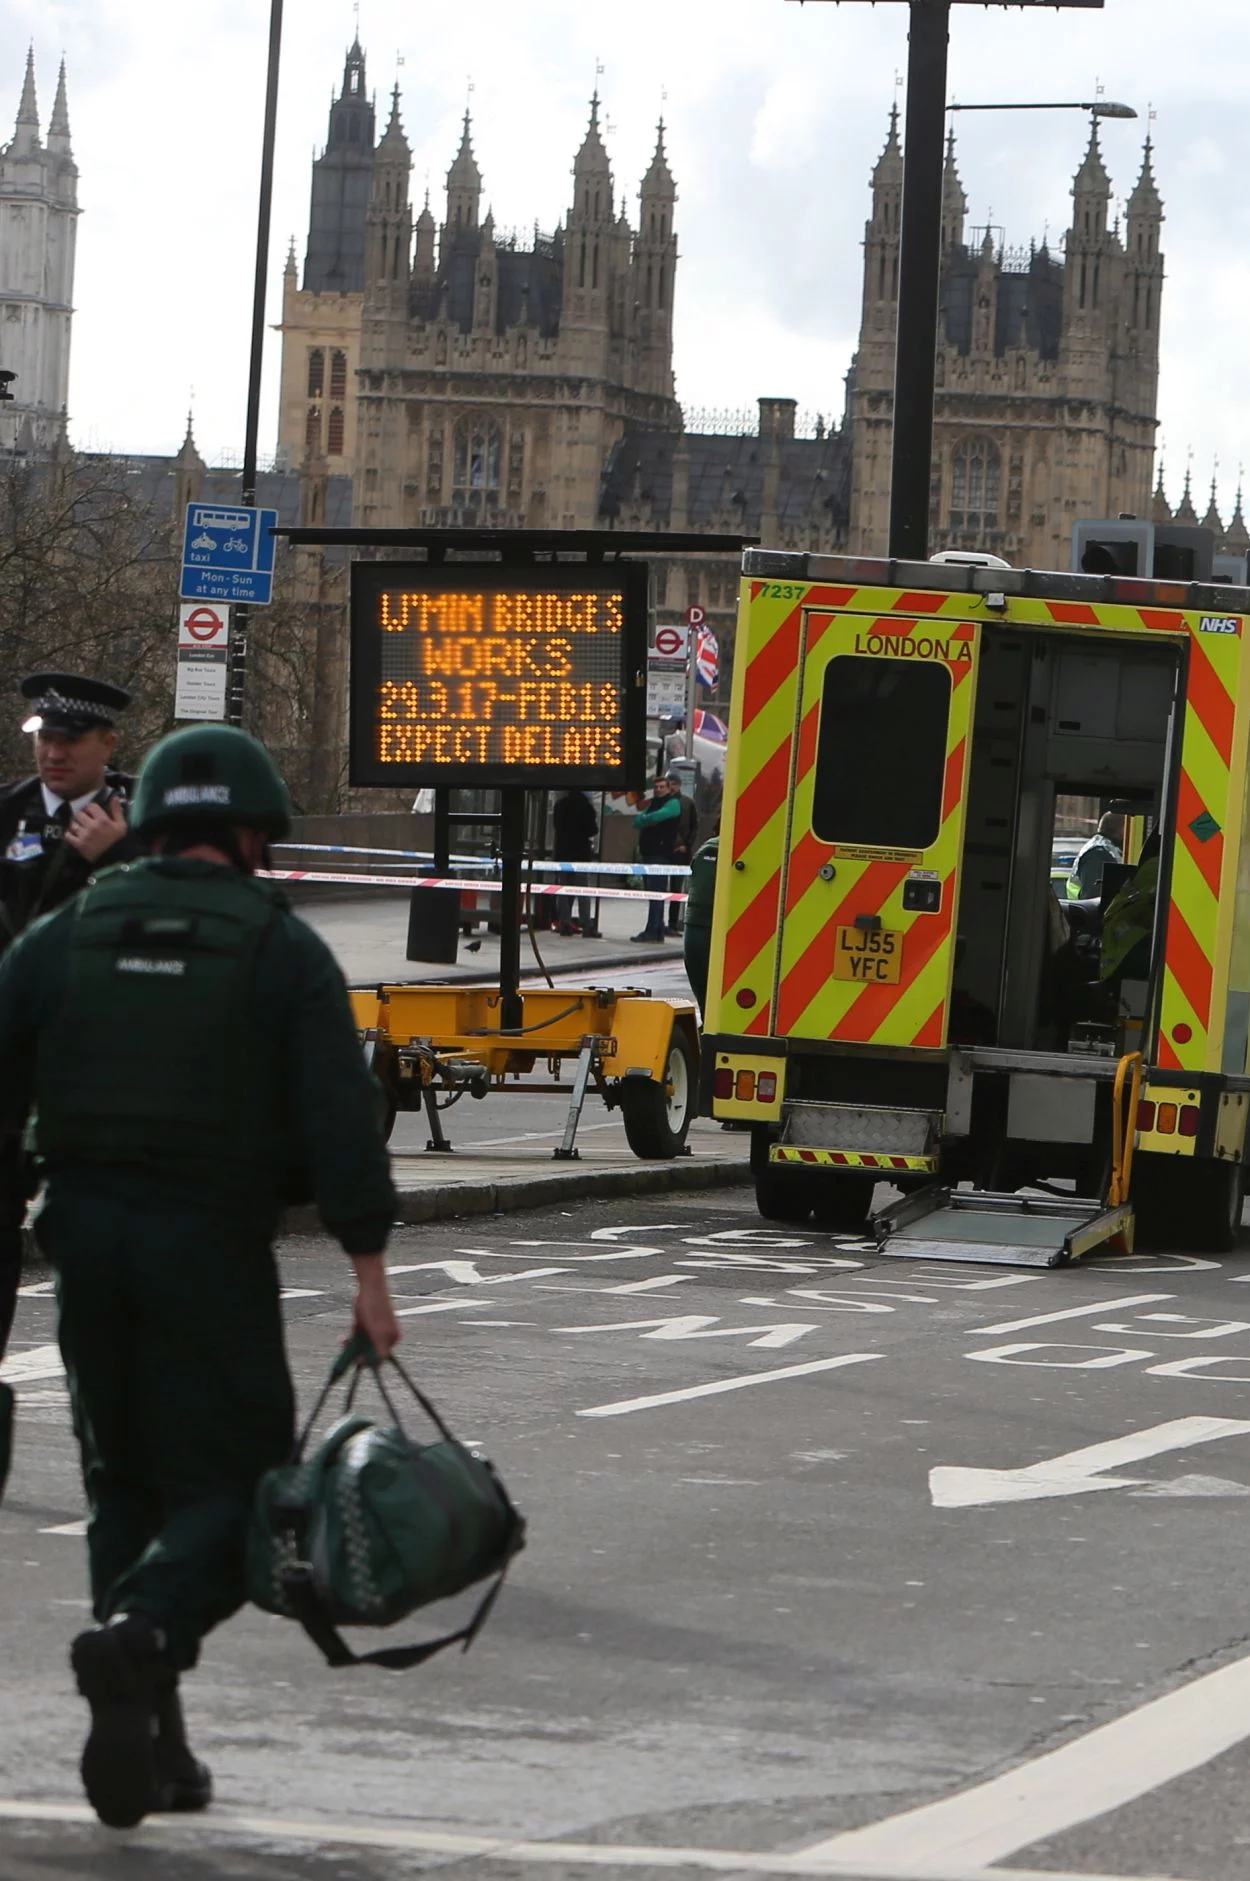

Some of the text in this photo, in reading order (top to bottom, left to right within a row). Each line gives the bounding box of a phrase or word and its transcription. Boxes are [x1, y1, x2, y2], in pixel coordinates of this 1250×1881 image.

[190, 552, 211, 562] taxi
[201, 571, 224, 582] Mon
[232, 574, 253, 585] Sun
[196, 585, 256, 598] at any time
[760, 584, 805, 601] 7237
[493, 593, 624, 634] BRIDGES
[690, 608, 703, 623] D
[1200, 617, 1237, 634] NHS
[421, 636, 573, 677] WORKS
[854, 633, 950, 660] LONDON
[379, 723, 622, 766] EXPECT DELAYS
[841, 928, 895, 954] LJ55
[849, 956, 889, 980] YFC
